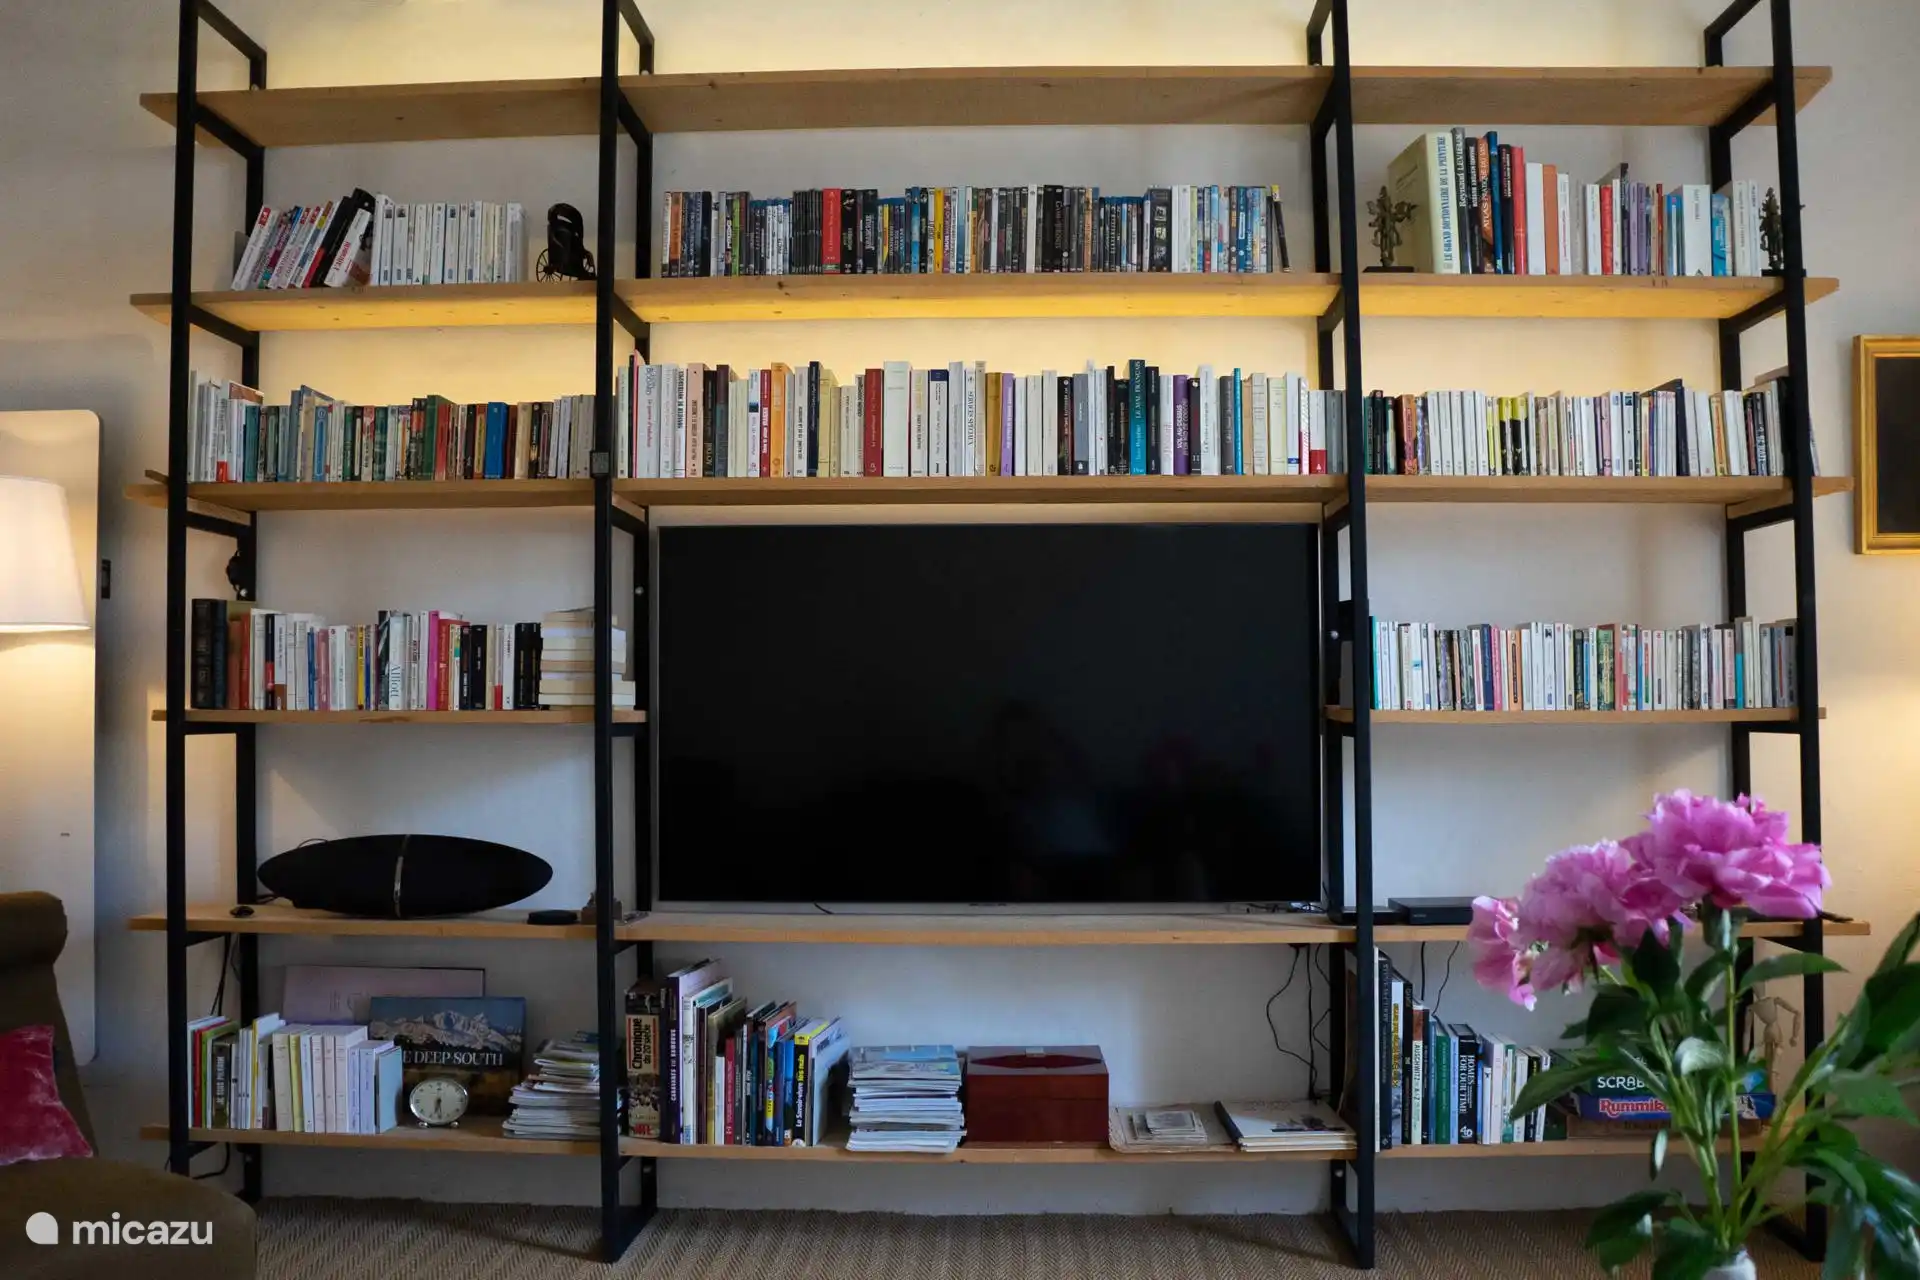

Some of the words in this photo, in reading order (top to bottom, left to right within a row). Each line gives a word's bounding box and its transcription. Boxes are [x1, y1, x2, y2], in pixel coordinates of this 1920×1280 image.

[1436, 136, 1447, 166] PEINTURE
[1457, 173, 1468, 207] Reynaud
[1480, 170, 1490, 201] PRATIQUE
[1440, 187, 1451, 230] DICTIONNAIRE
[1482, 202, 1490, 229] ATLAS
[1442, 231, 1452, 252] GRAND
[414, 1051, 451, 1066] DEEP
[453, 1051, 504, 1066] SOUTH
[631, 1018, 645, 1070] Chronique
[796, 1082, 804, 1118] Savoir-vivre
